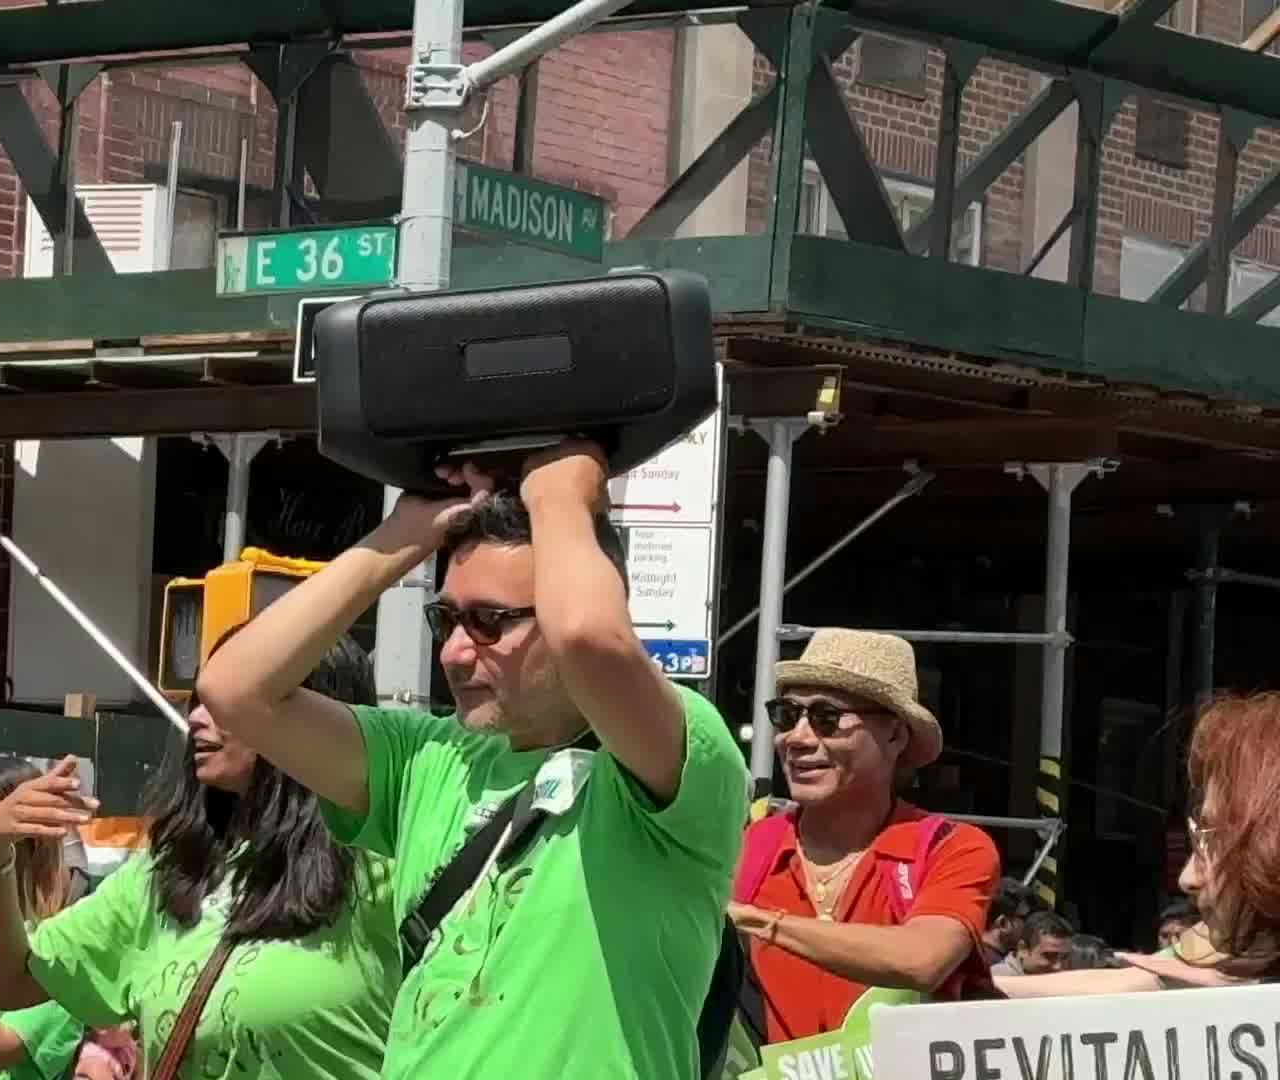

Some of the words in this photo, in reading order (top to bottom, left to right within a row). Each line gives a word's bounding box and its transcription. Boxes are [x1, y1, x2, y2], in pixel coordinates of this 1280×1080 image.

[472, 175, 573, 243] MADISON
[256, 241, 277, 286] E
[296, 237, 344, 282] 36
[356, 232, 386, 258] ST
